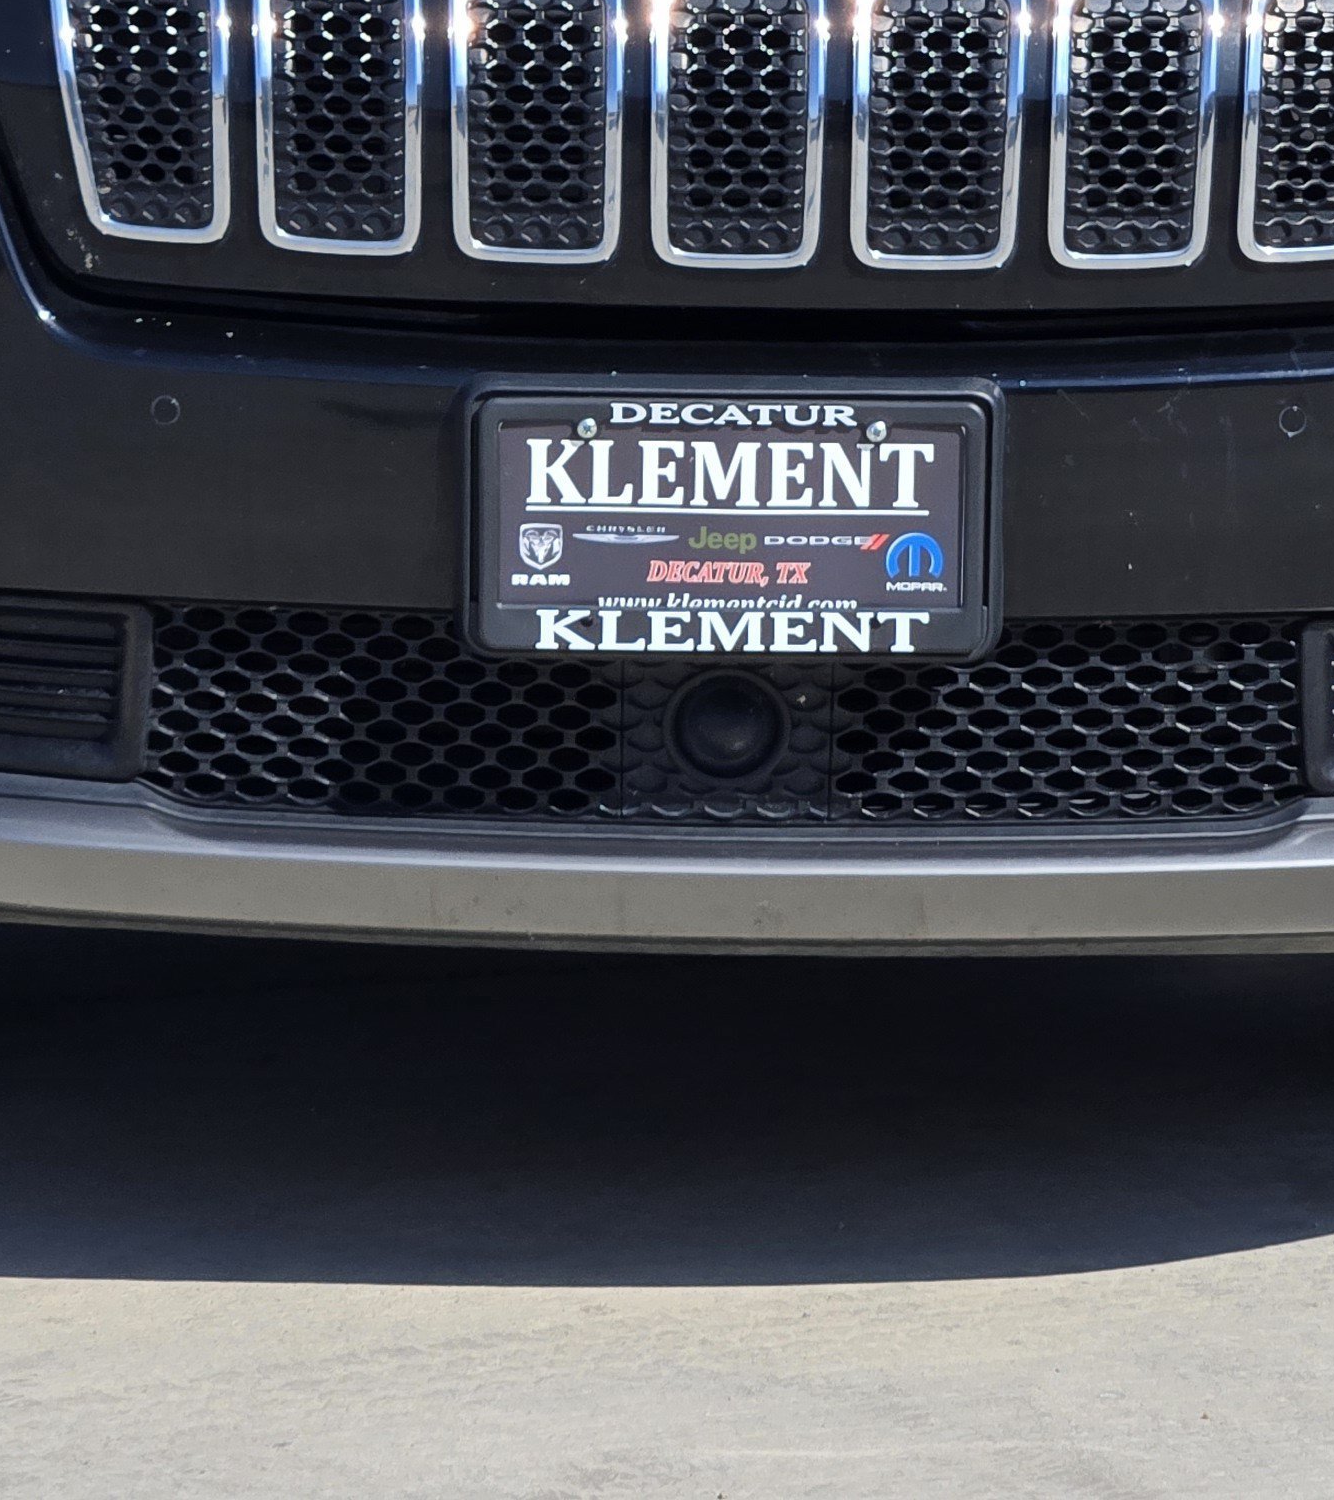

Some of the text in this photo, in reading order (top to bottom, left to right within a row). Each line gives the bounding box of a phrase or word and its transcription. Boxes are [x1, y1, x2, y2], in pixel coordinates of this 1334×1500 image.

[609, 402, 858, 427] DECATUR
[525, 438, 935, 508] KLEMENT
[688, 526, 758, 554] Jeep
[764, 535, 874, 546] DODGE
[511, 573, 571, 586] RAM
[646, 560, 812, 587] DECATUR, TX
[535, 608, 931, 654] KLEMENT
